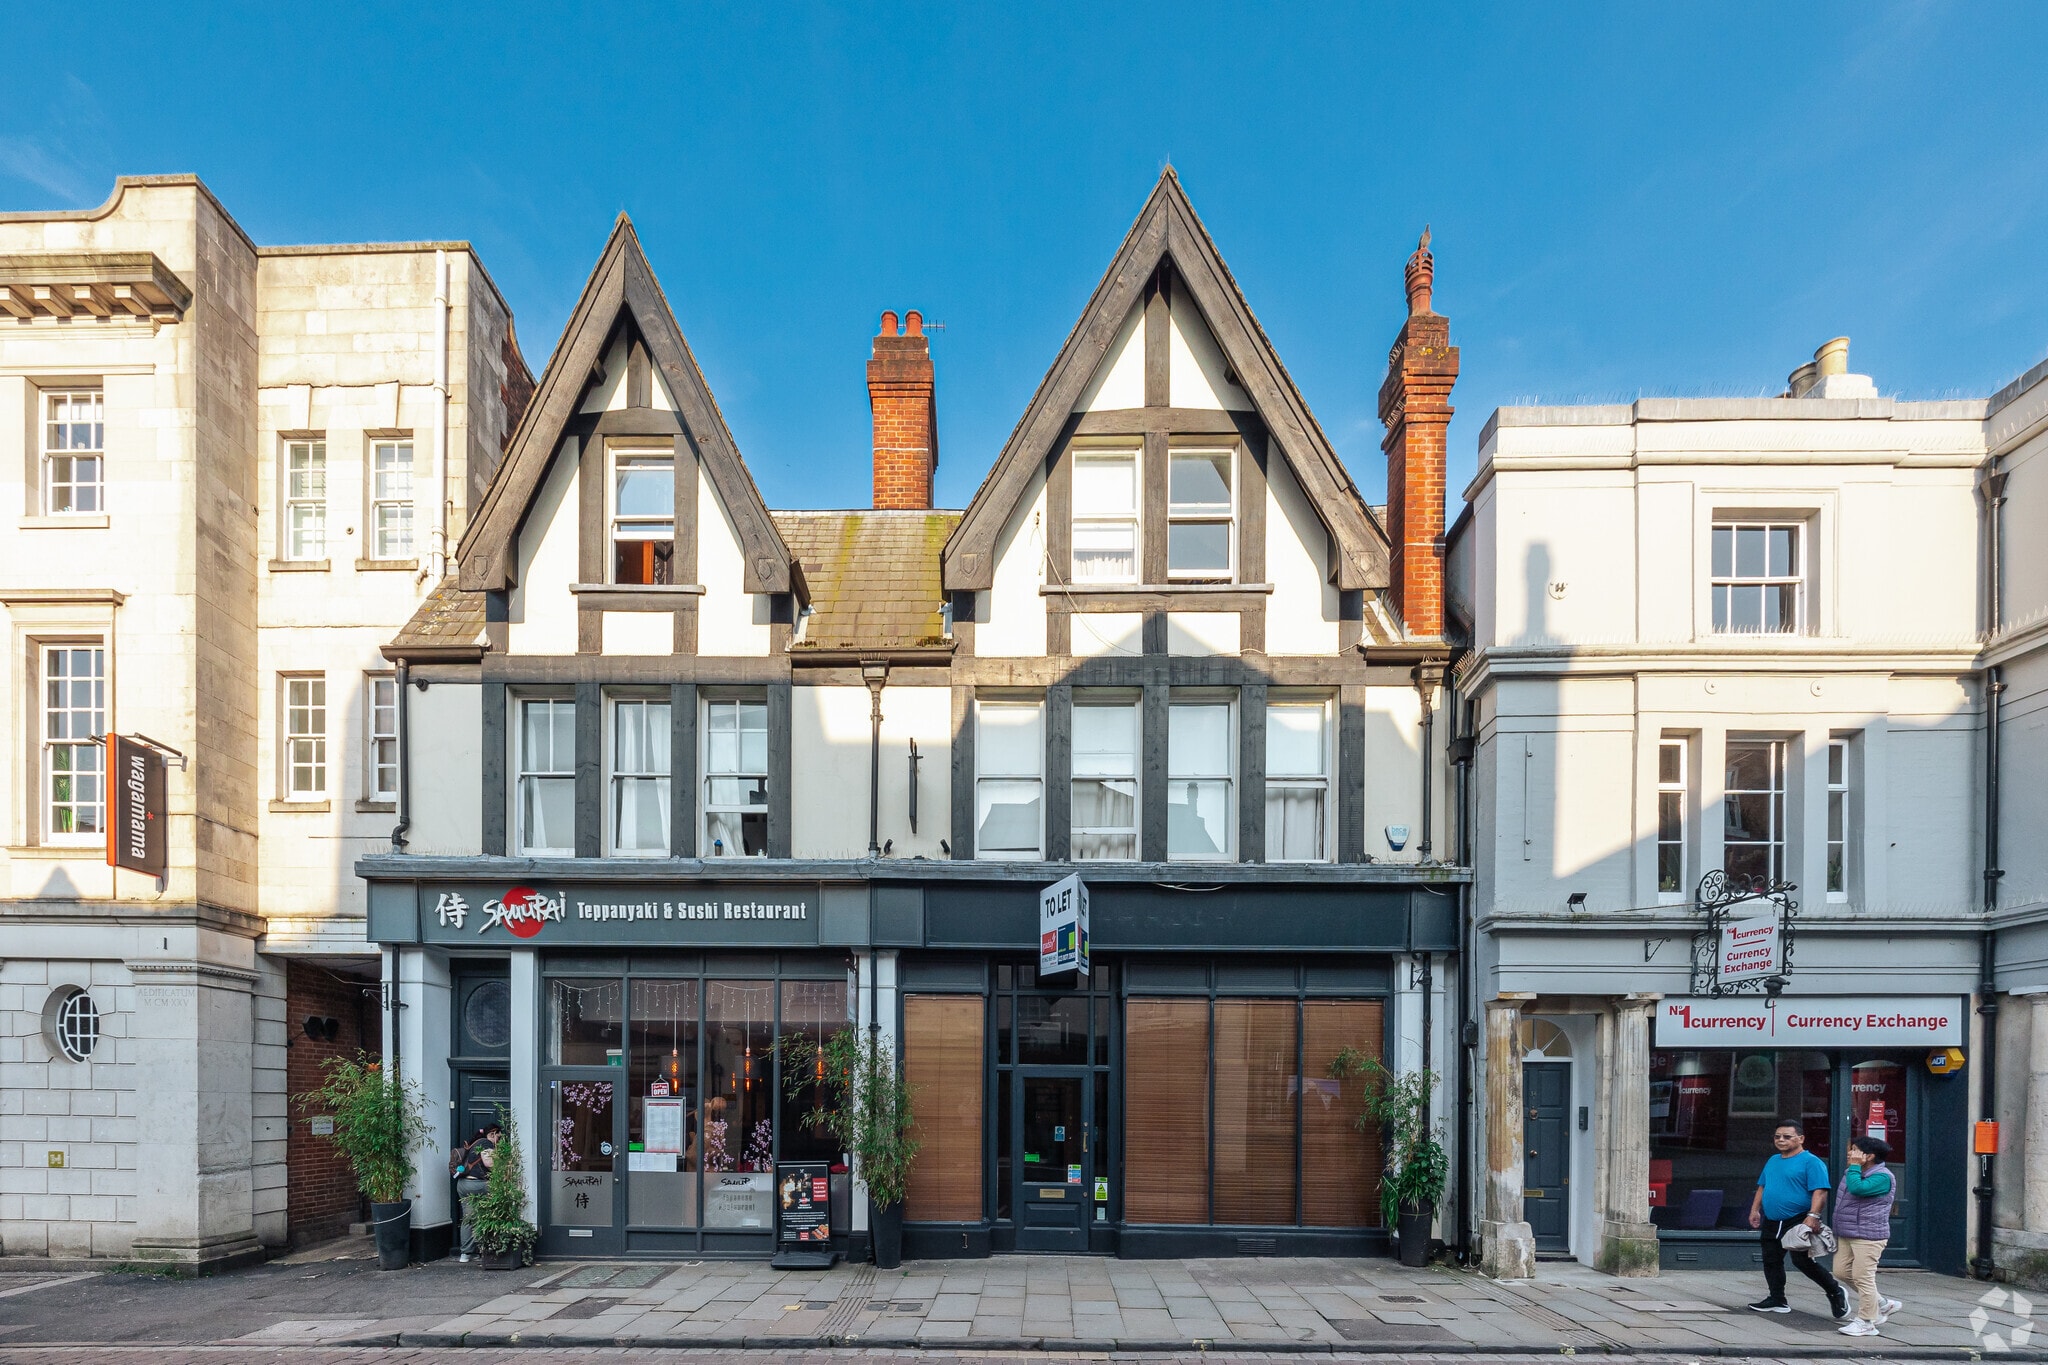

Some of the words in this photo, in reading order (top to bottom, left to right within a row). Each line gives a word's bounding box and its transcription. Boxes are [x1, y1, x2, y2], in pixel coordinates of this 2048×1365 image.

[127, 755, 146, 859] wagamama
[434, 892, 469, 930] 侍
[577, 902, 658, 922] Teppanyaki
[664, 902, 673, 919] &
[678, 902, 718, 919] Sushi
[724, 902, 807, 919] Restaurant
[1045, 897, 1056, 919] TO
[1058, 888, 1072, 914] LET
[1727, 947, 1771, 961] Currency
[1724, 960, 1772, 974] Exchange
[1787, 1014, 1862, 1031] Currency
[1866, 1013, 1948, 1031] Exchange
[1931, 1056, 1946, 1065] ADT
[574, 1192, 590, 1209] 侍
